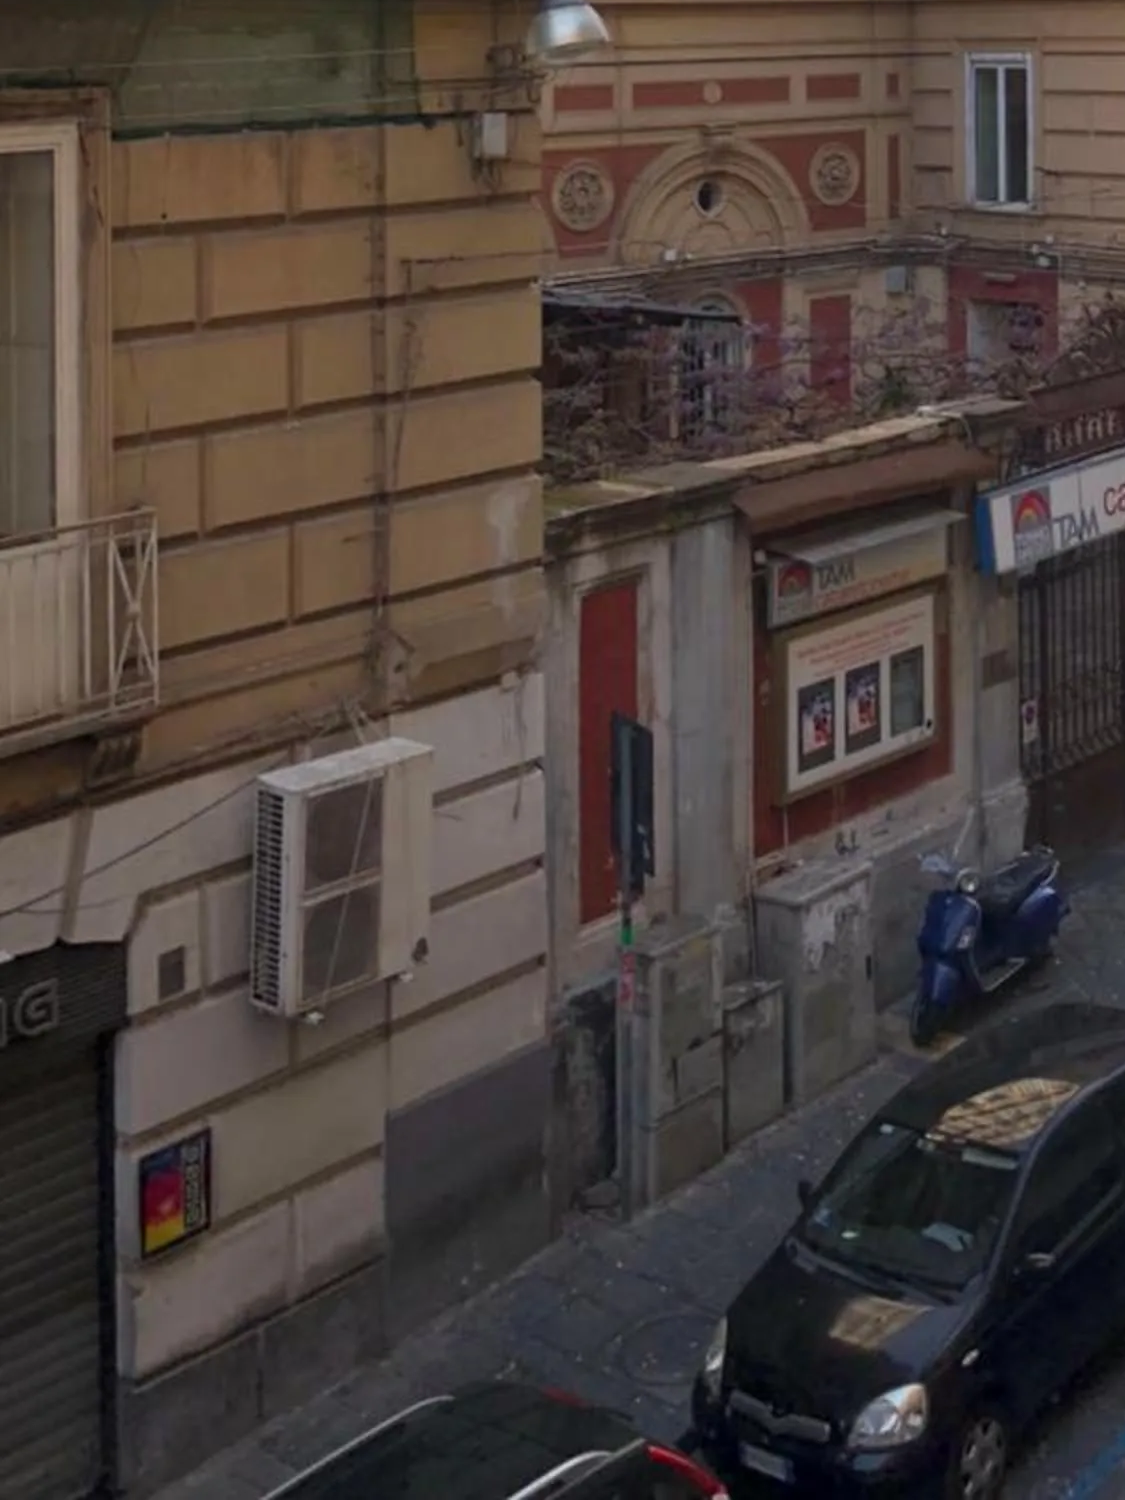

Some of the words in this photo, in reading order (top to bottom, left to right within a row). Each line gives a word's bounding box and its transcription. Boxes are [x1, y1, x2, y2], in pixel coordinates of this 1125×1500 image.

[1053, 506, 1100, 549] TAM
[817, 555, 855, 589] TAM
[0, 978, 59, 1048] G
